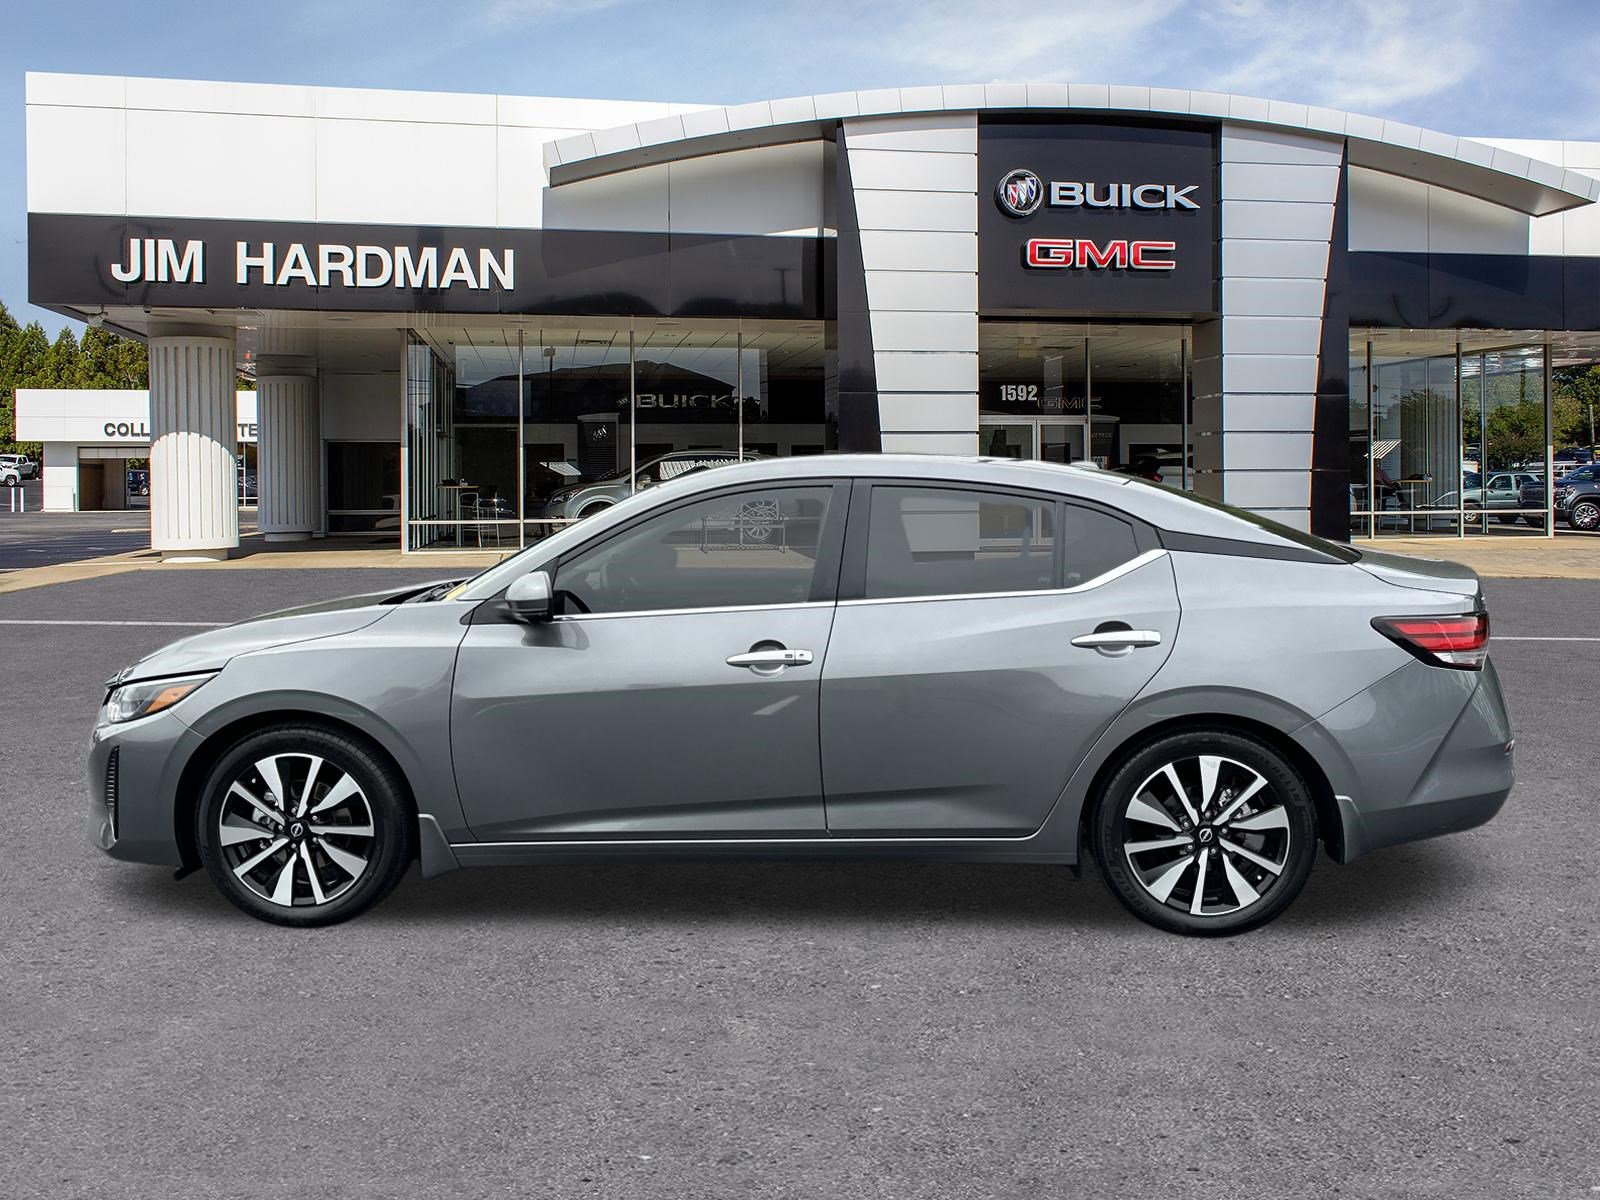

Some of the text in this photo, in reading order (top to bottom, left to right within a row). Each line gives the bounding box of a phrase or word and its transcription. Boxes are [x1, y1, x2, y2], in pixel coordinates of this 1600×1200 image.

[1050, 181, 1200, 209] BUICK
[111, 238, 515, 290] JIM HARDMAN
[1026, 238, 1176, 270] GMC
[636, 394, 732, 408] BUICK
[1000, 385, 1037, 401] 1592
